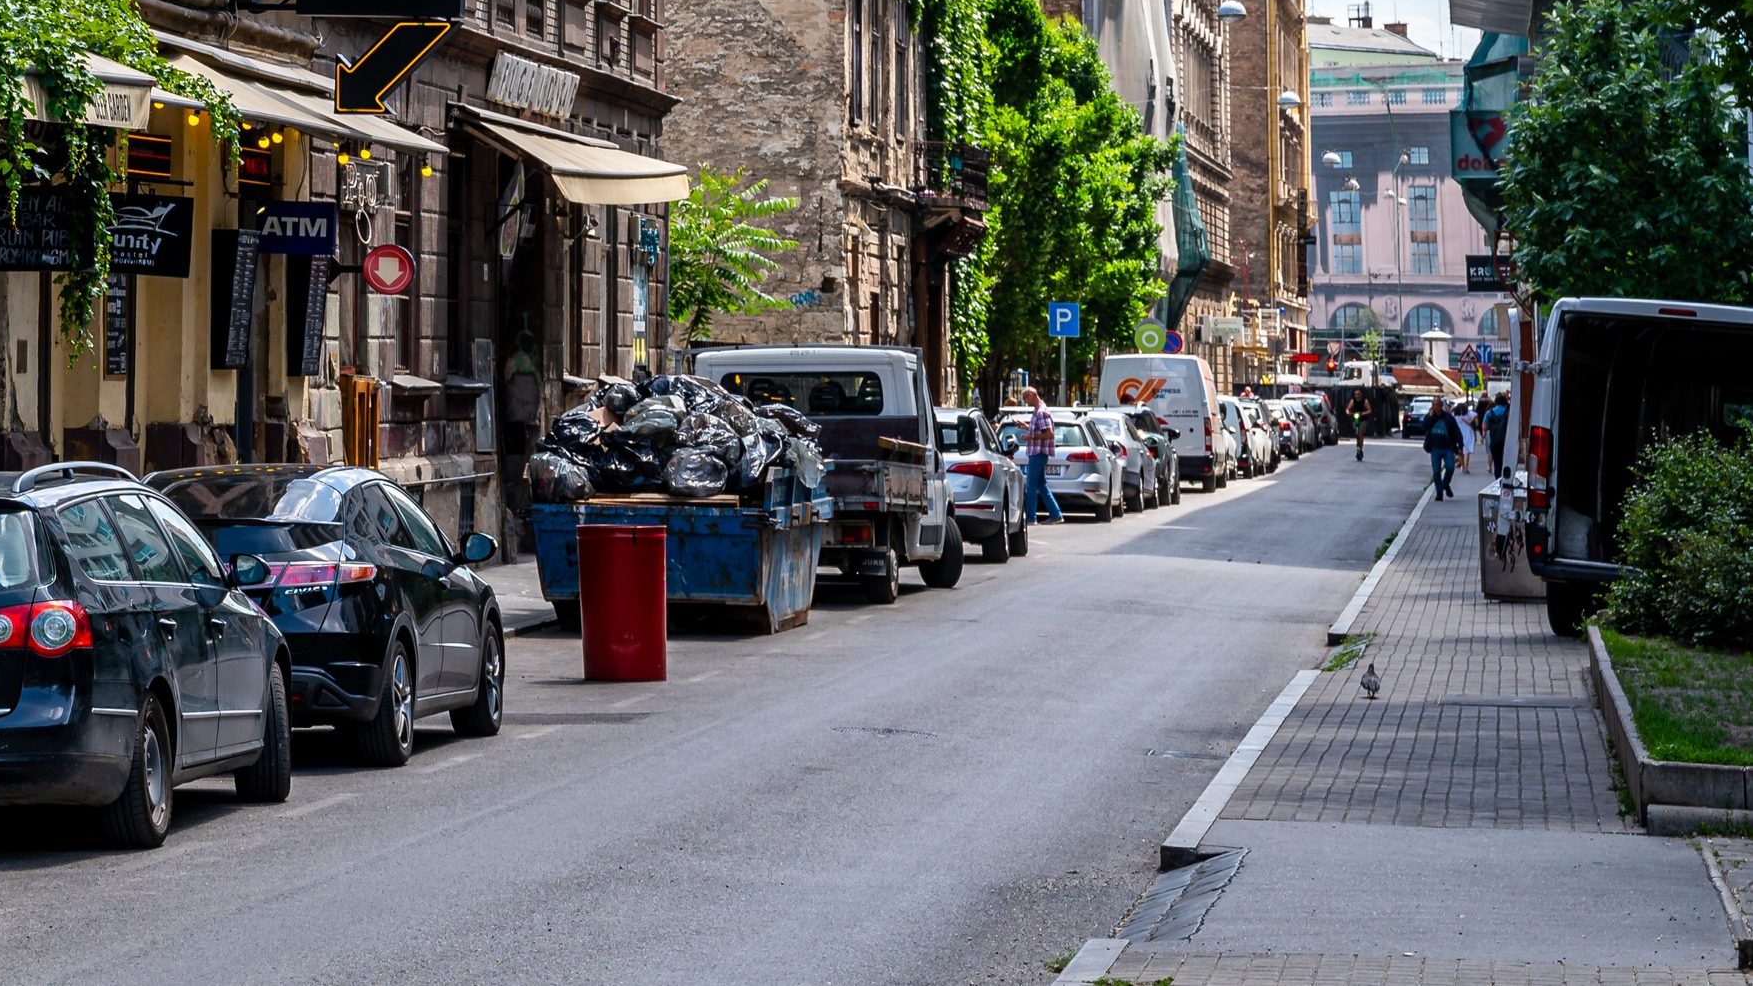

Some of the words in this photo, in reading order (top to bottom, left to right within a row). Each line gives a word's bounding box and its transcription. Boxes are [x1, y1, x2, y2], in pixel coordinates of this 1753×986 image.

[108, 93, 131, 122] GARDEN
[21, 213, 56, 227] BAR
[261, 216, 327, 238] ATM
[113, 233, 162, 255] unity
[1056, 308, 1072, 331] P
